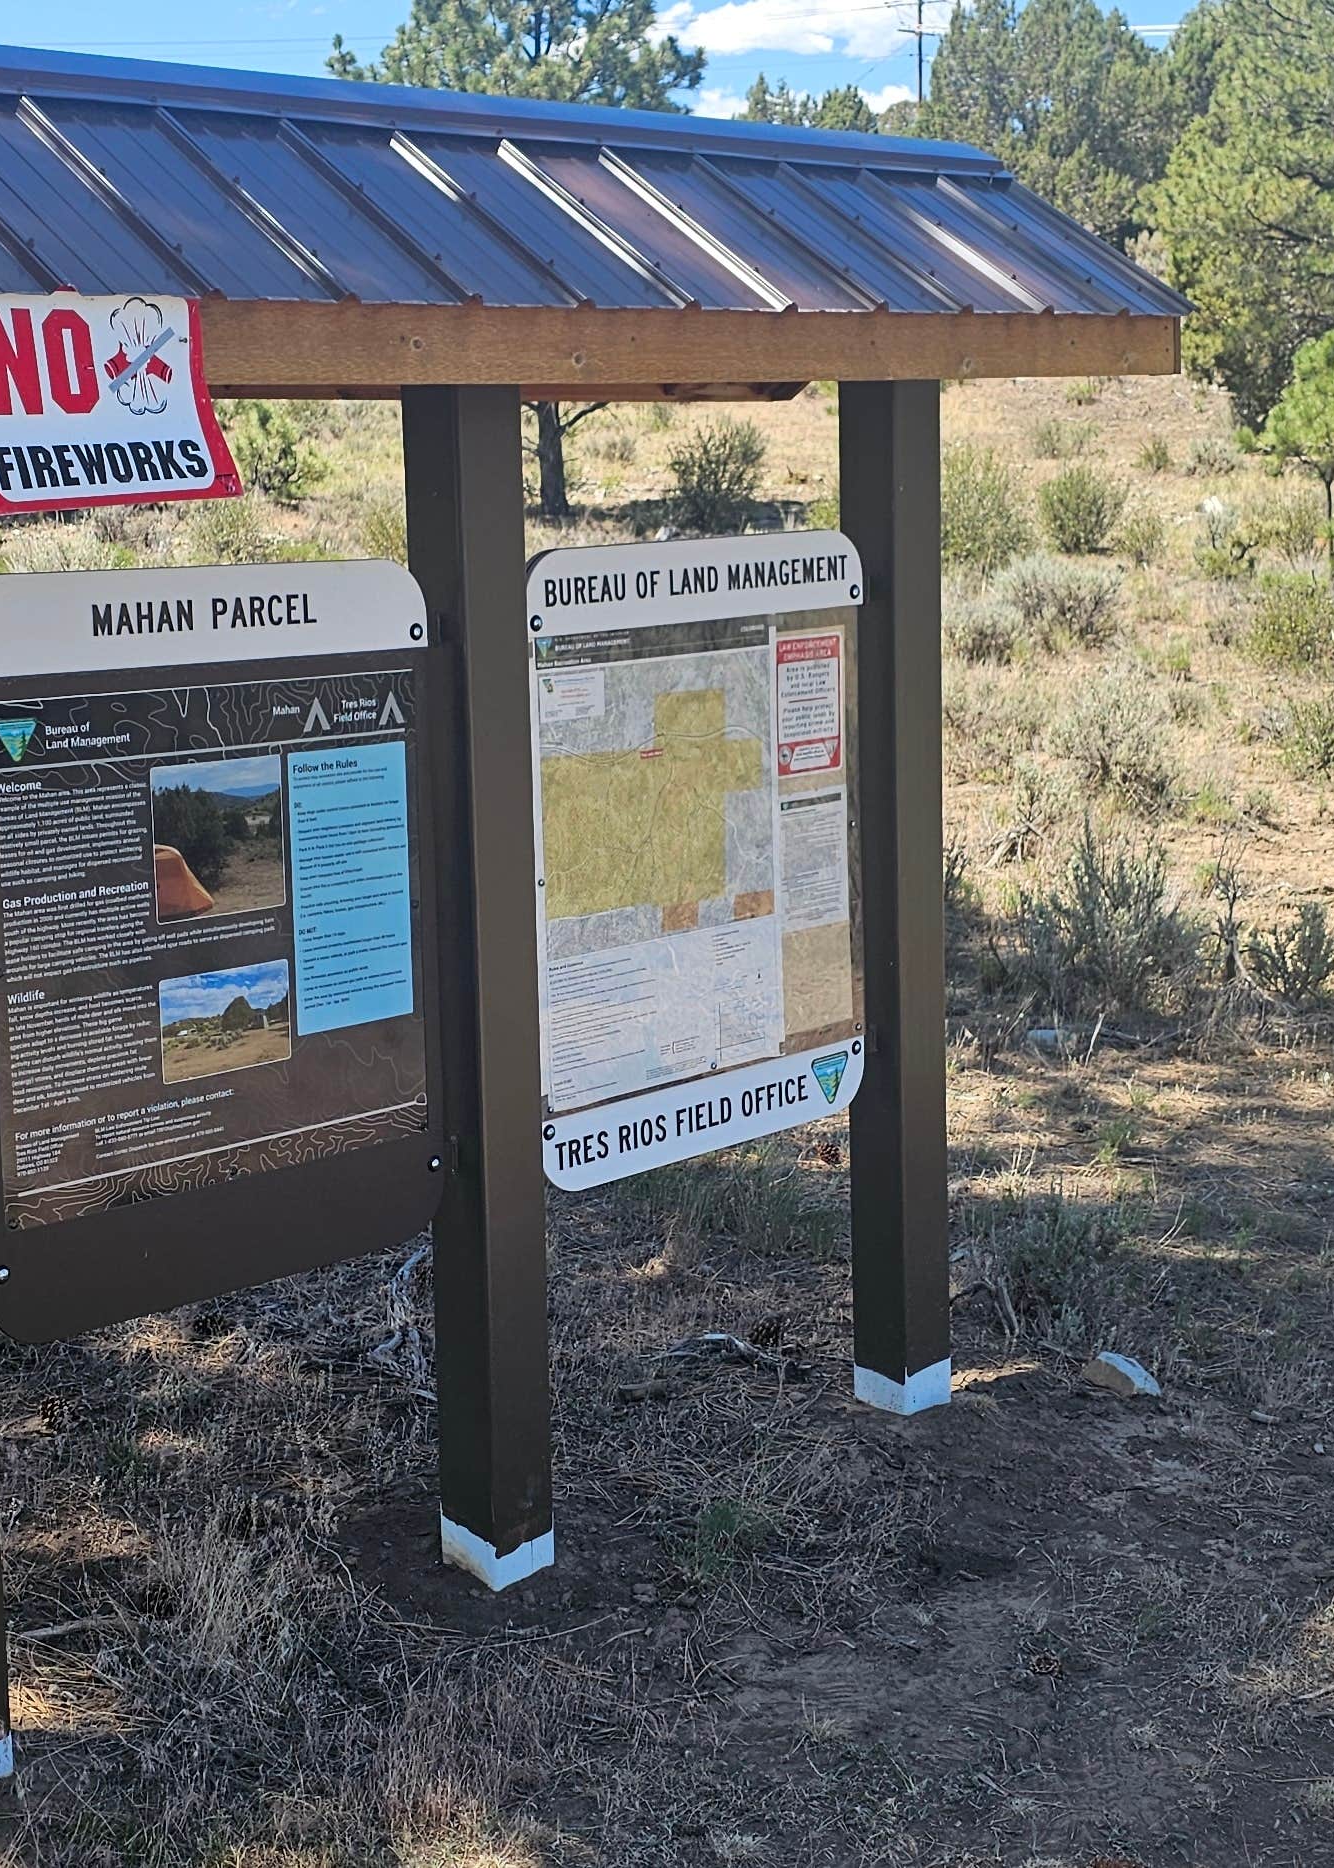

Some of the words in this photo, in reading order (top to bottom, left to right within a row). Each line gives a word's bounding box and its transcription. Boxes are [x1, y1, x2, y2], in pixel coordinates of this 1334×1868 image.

[544, 573, 627, 607] BUREAU
[636, 570, 660, 599] OF
[669, 566, 719, 596] LAND
[727, 554, 848, 591] MANAGEMENT
[92, 599, 194, 637] MAHAN
[212, 593, 318, 630] PARCEL
[554, 642, 574, 652] BUREAU
[596, 638, 631, 647] MANAGEMENT
[793, 638, 837, 649] ENFORCEMENT
[272, 705, 301, 716] Mahan
[341, 699, 358, 709] Tres
[359, 697, 377, 707] Rios
[333, 713, 353, 723] Field
[353, 711, 377, 721] Office
[45, 725, 78, 735] Bureau
[80, 721, 90, 732] of
[45, 738, 68, 749] Land
[70, 732, 131, 748] Management
[292, 763, 319, 774] Follow
[321, 760, 334, 770] the
[335, 758, 358, 769] Rules
[1, 896, 21, 909] Gas
[23, 889, 76, 906] Production
[78, 886, 96, 898] and
[98, 878, 149, 895] Recreation
[7, 989, 46, 1004] Wildlife
[14, 1130, 28, 1142] For
[29, 1127, 50, 1138] more
[51, 1116, 96, 1134] information
[97, 1116, 105, 1124] or
[107, 1112, 115, 1122] to
[116, 1107, 139, 1121] report
[146, 1098, 178, 1113] violation,
[180, 1093, 204, 1107] please
[205, 1086, 234, 1100] contact:
[555, 1131, 609, 1171] TRES
[618, 1114, 667, 1154] RIOS
[676, 1097, 732, 1137] FIELD
[741, 1075, 809, 1117] OFFICE
